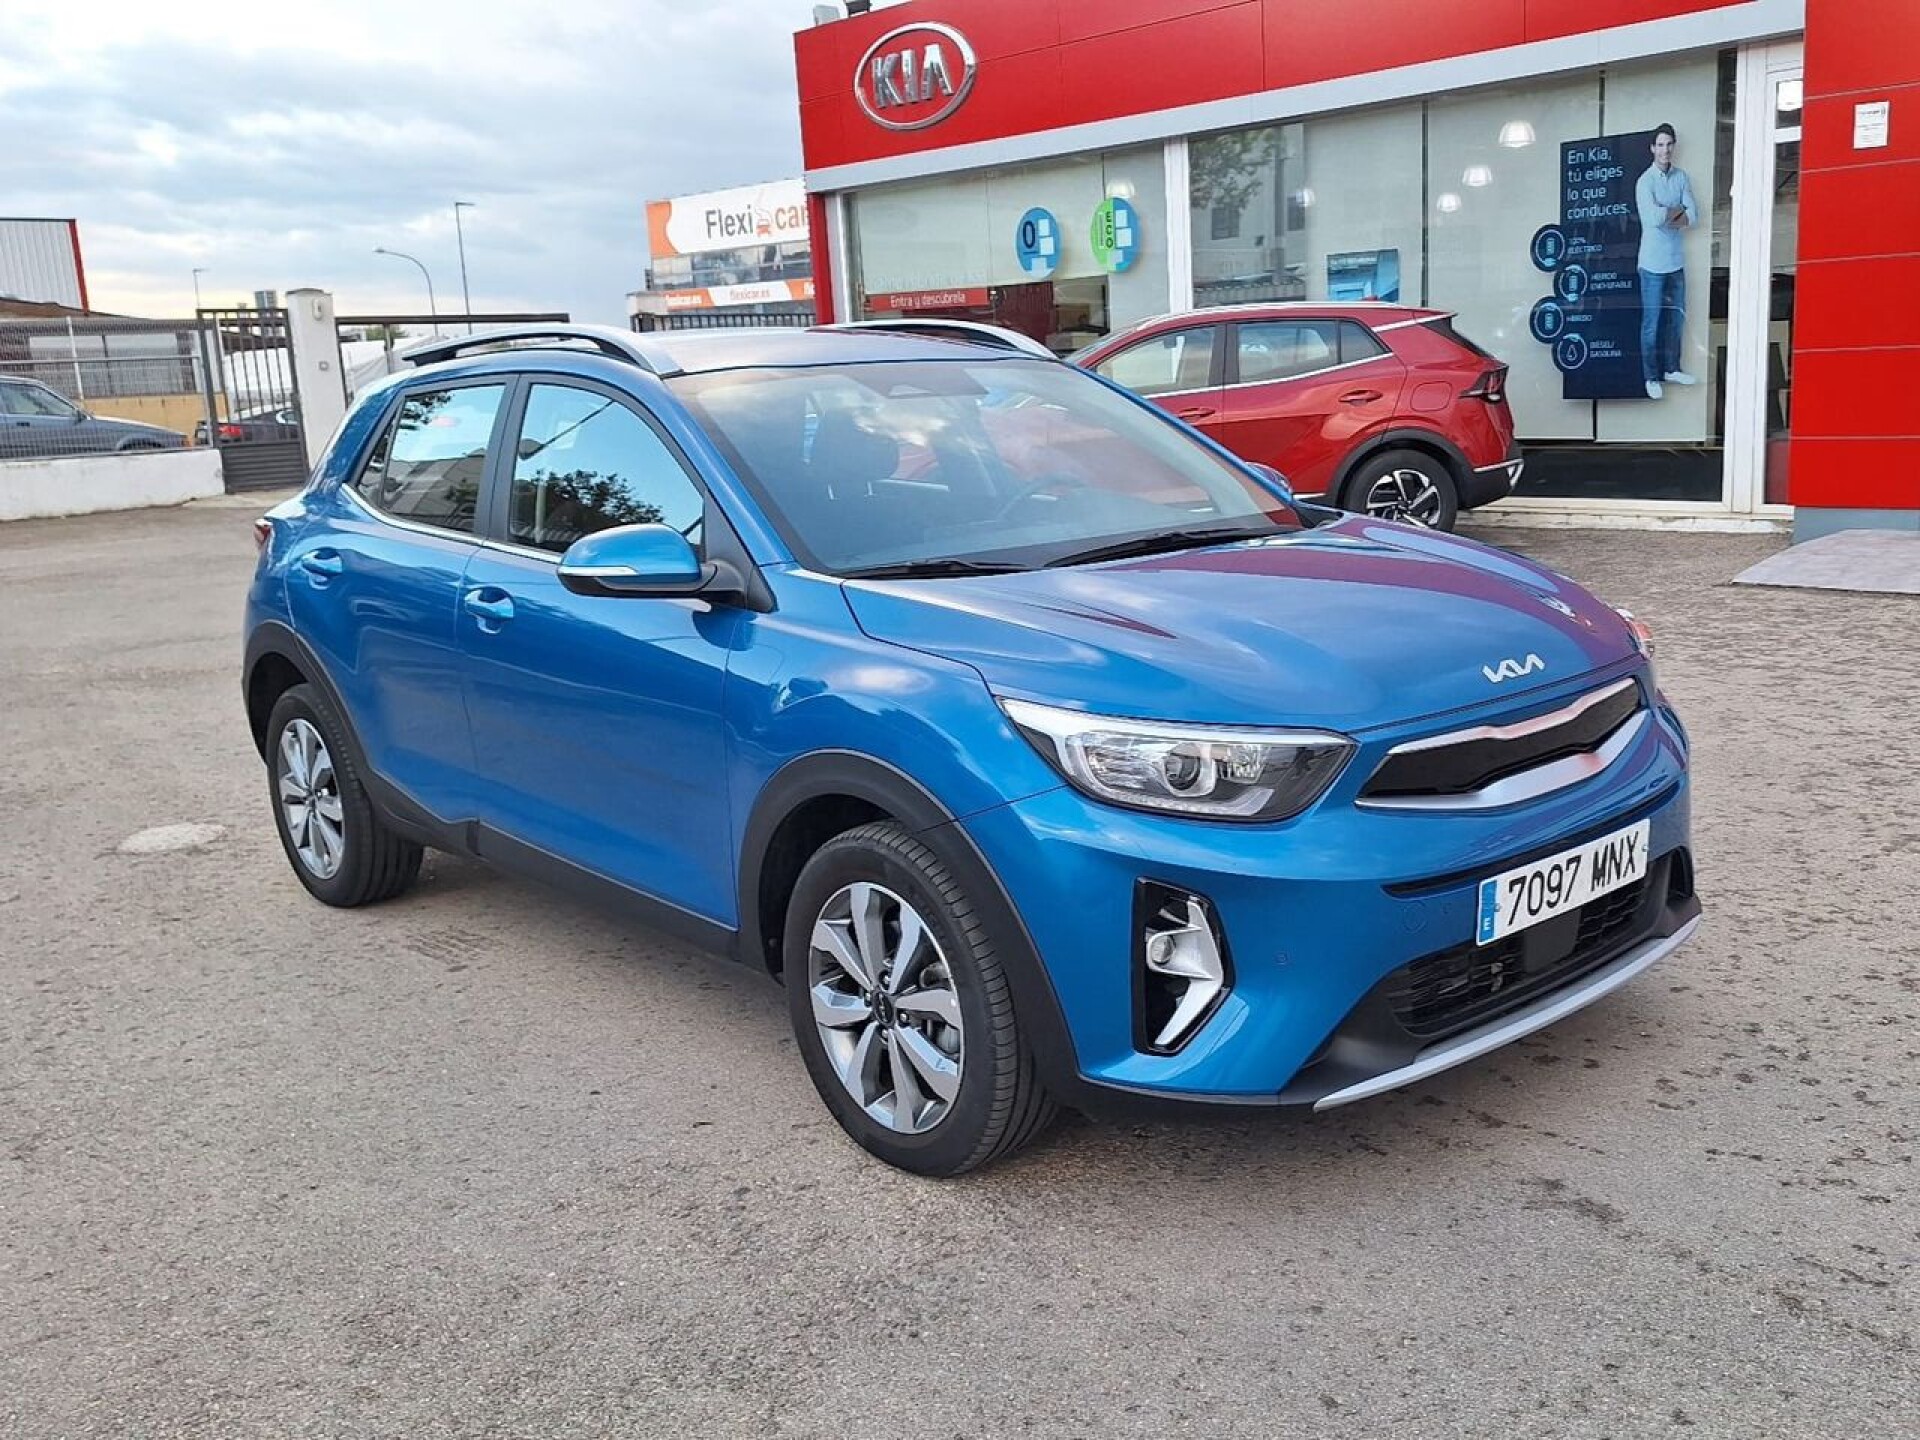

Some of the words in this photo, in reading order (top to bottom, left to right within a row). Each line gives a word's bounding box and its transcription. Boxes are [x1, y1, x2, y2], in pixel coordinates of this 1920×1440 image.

[872, 43, 955, 108] KIA
[1567, 150, 1585, 164] En
[1588, 147, 1612, 162] Kia,
[1585, 165, 1624, 182] eliges
[1567, 187, 1579, 201] lo
[1582, 186, 1606, 202] que
[1567, 202, 1631, 220] conduces.
[705, 204, 754, 239] Flexi
[1105, 211, 1114, 249] ECO
[890, 295, 913, 308] Entra
[1507, 854, 1582, 926] 7097
[1590, 831, 1639, 892] MNX
[1483, 917, 1492, 931] E
